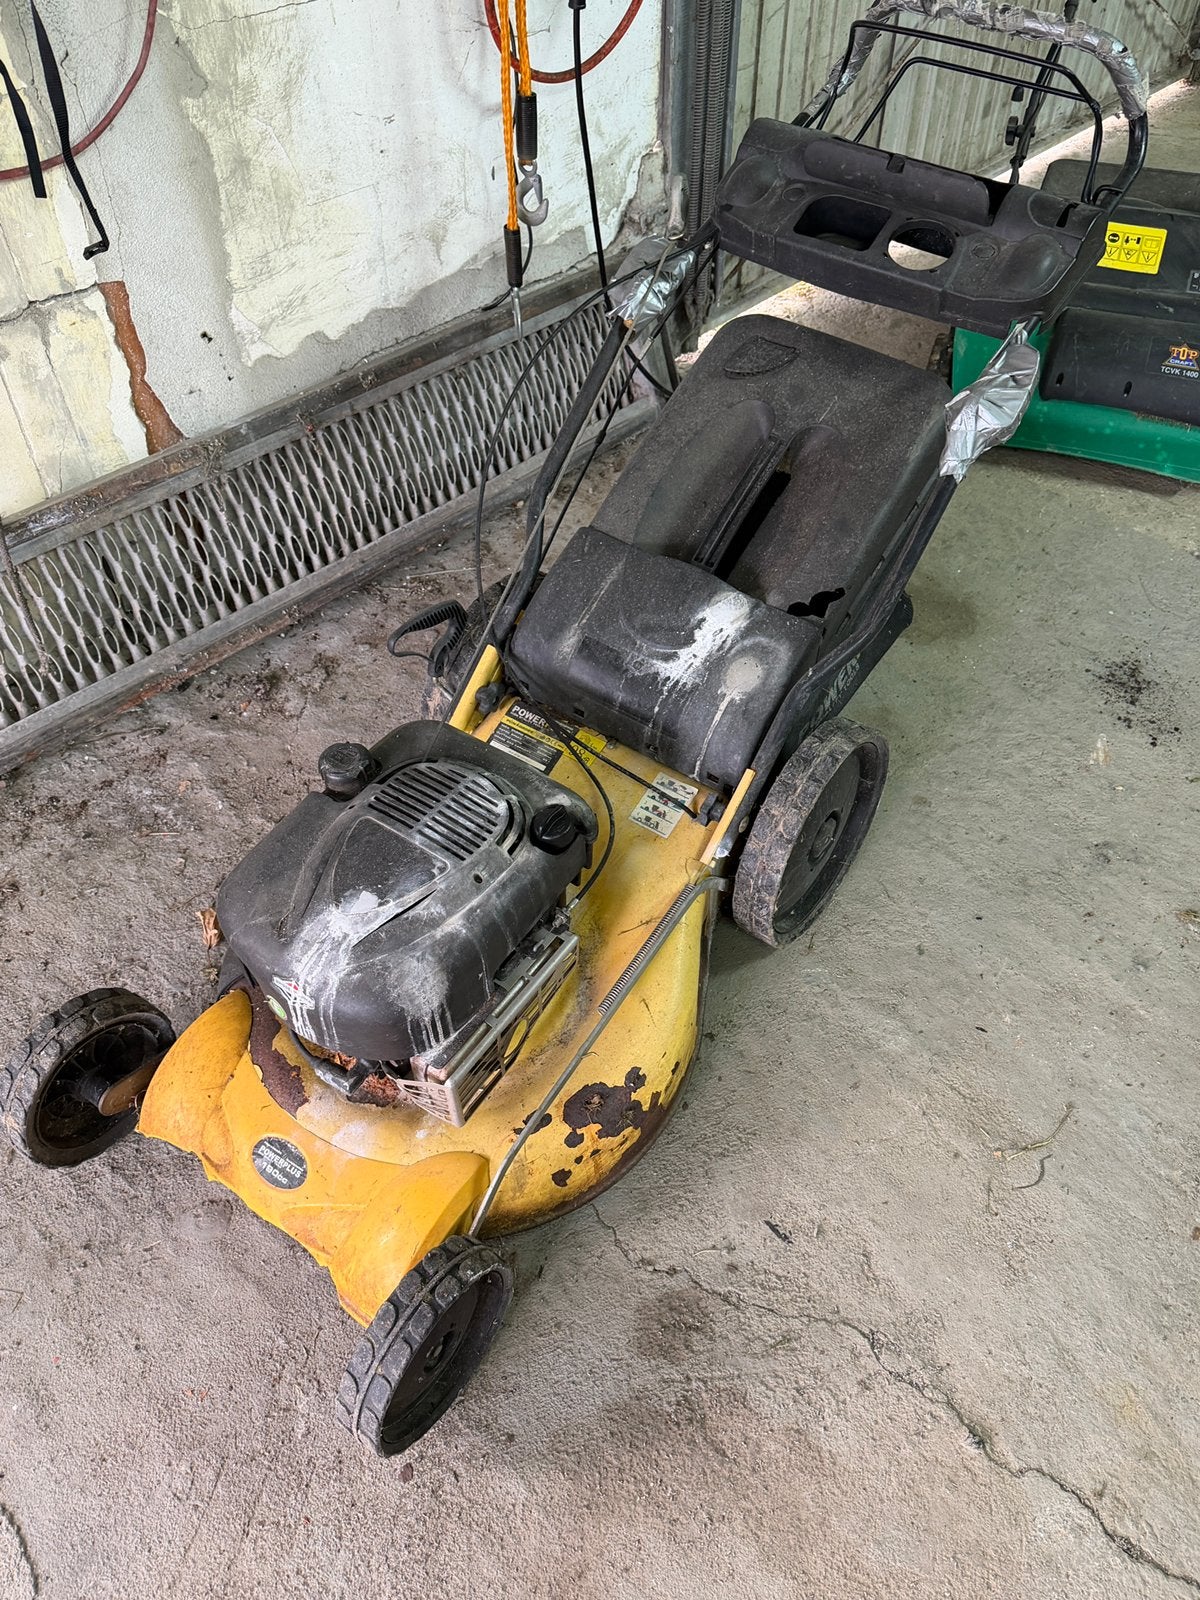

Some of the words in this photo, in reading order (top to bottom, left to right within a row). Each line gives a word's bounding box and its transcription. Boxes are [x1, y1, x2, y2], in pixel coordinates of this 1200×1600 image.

[1171, 347, 1198, 360] TOP
[1161, 366, 1181, 375] TCVK
[1182, 370, 1199, 379] 1400
[258, 1145, 302, 1178] POWERPLUS
